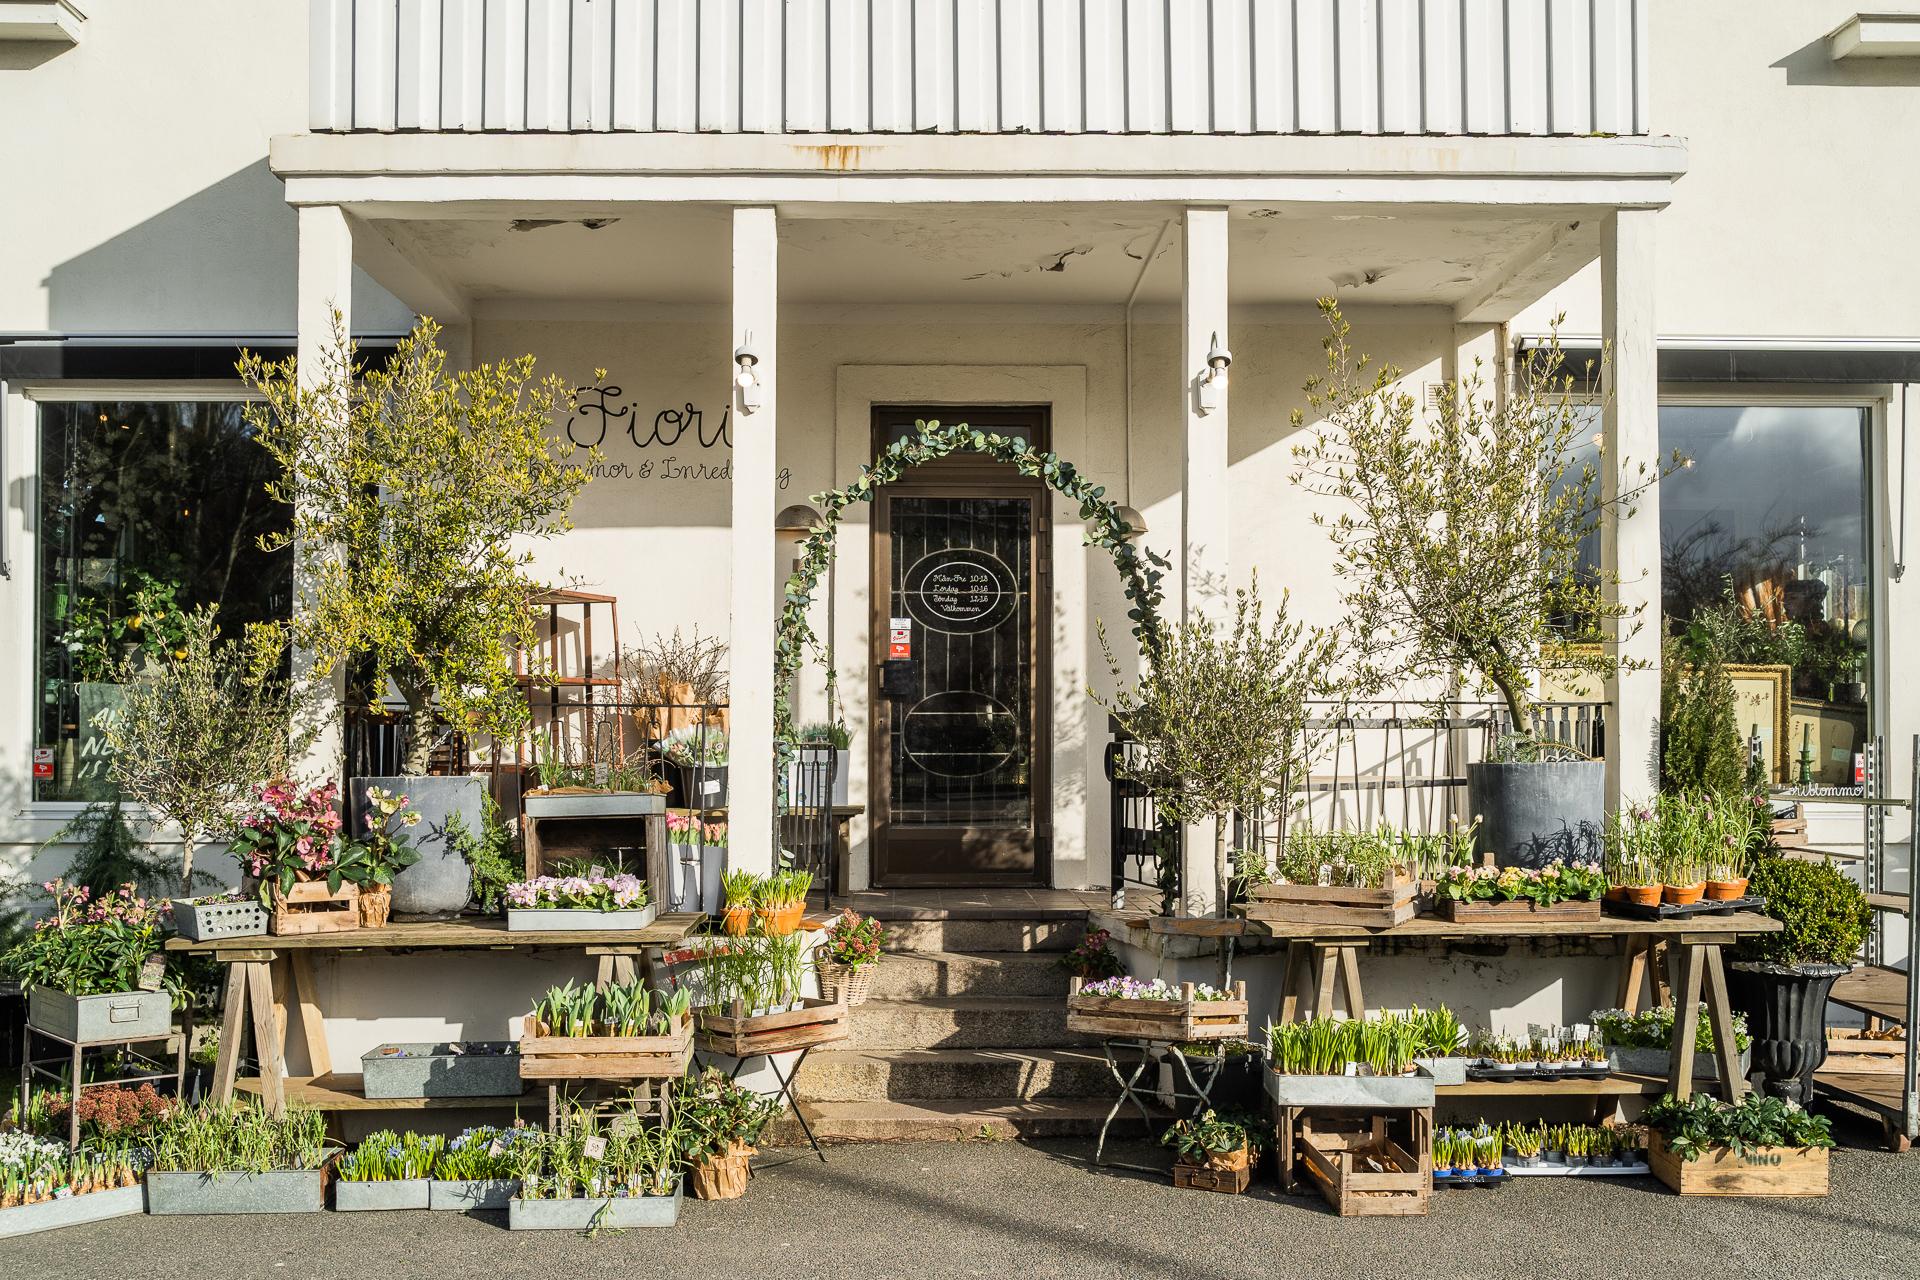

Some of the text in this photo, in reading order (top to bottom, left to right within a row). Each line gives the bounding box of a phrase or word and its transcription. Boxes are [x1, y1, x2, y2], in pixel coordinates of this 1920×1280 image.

[567, 386, 733, 448] Fiori
[639, 460, 654, 478] &
[661, 456, 792, 489] Inredg
